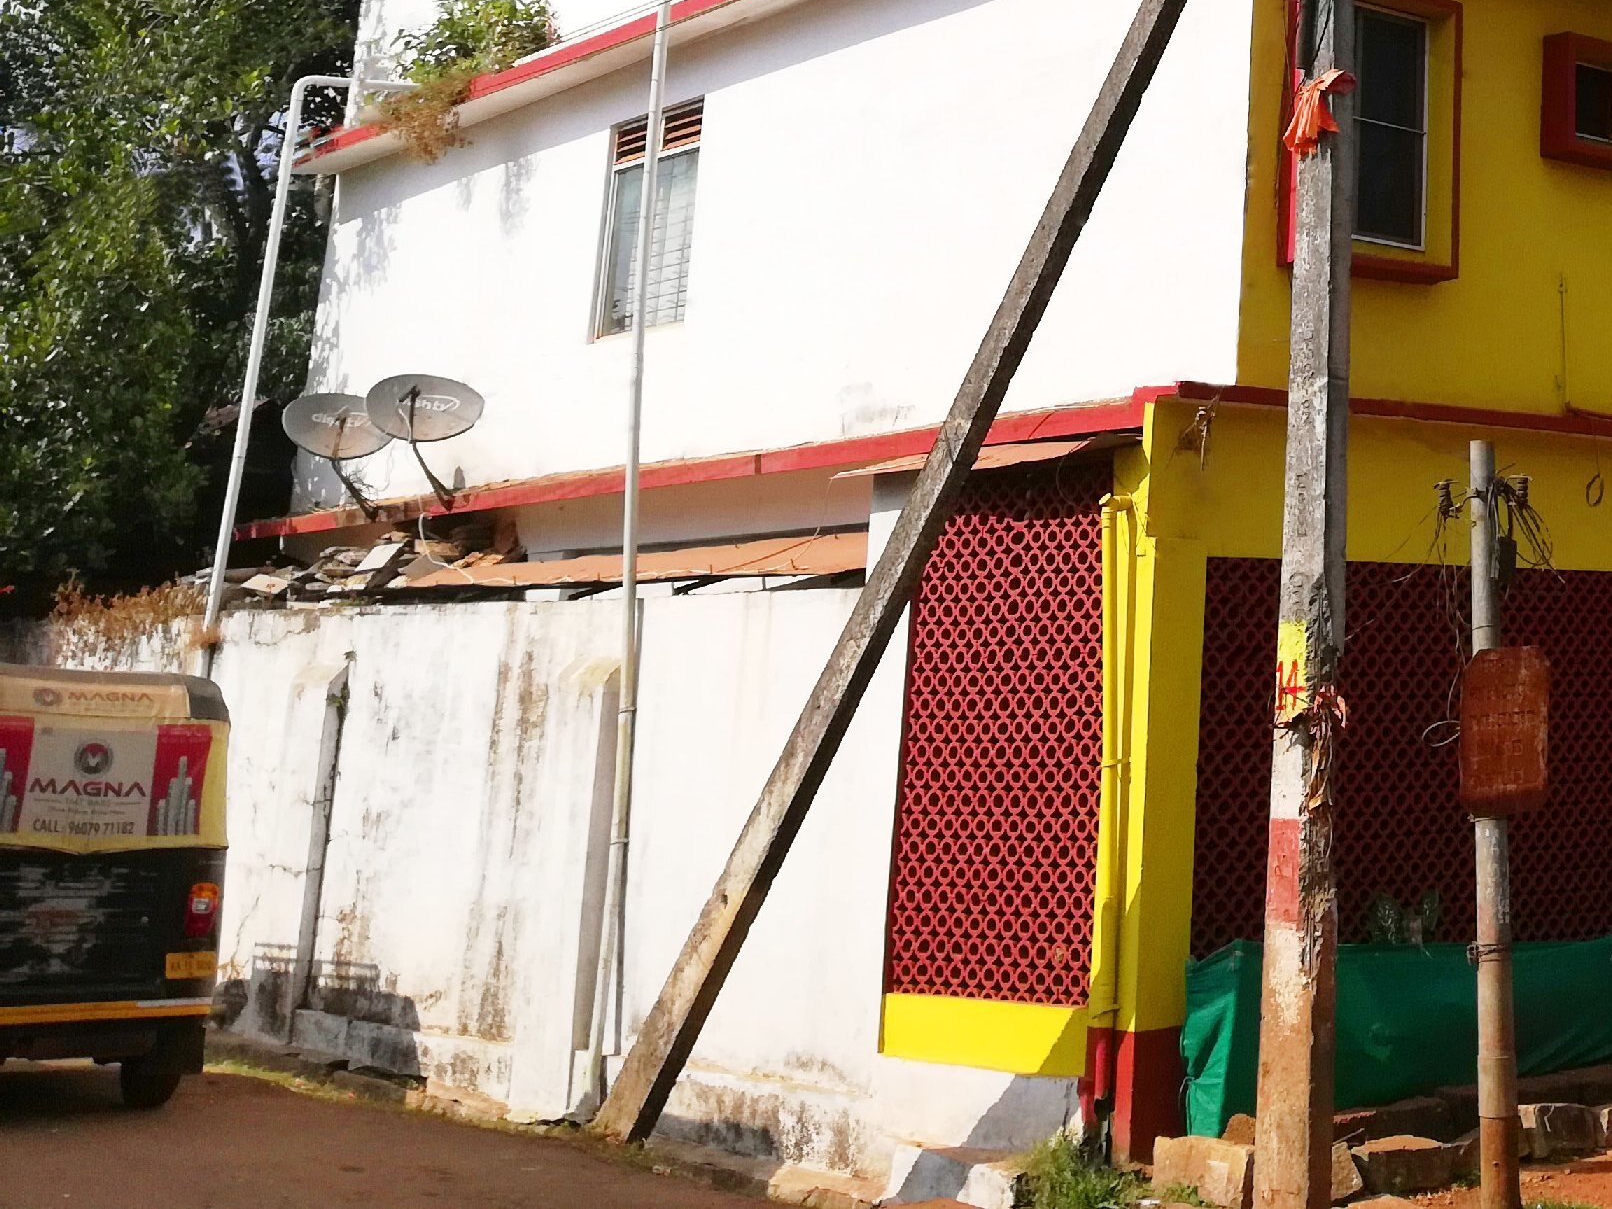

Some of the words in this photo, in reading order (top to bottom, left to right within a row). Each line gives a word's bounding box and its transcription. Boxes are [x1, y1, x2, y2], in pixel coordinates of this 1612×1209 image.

[68, 691, 154, 703] MAGNA
[29, 777, 147, 798] MAGNA
[33, 818, 60, 833] CALL
